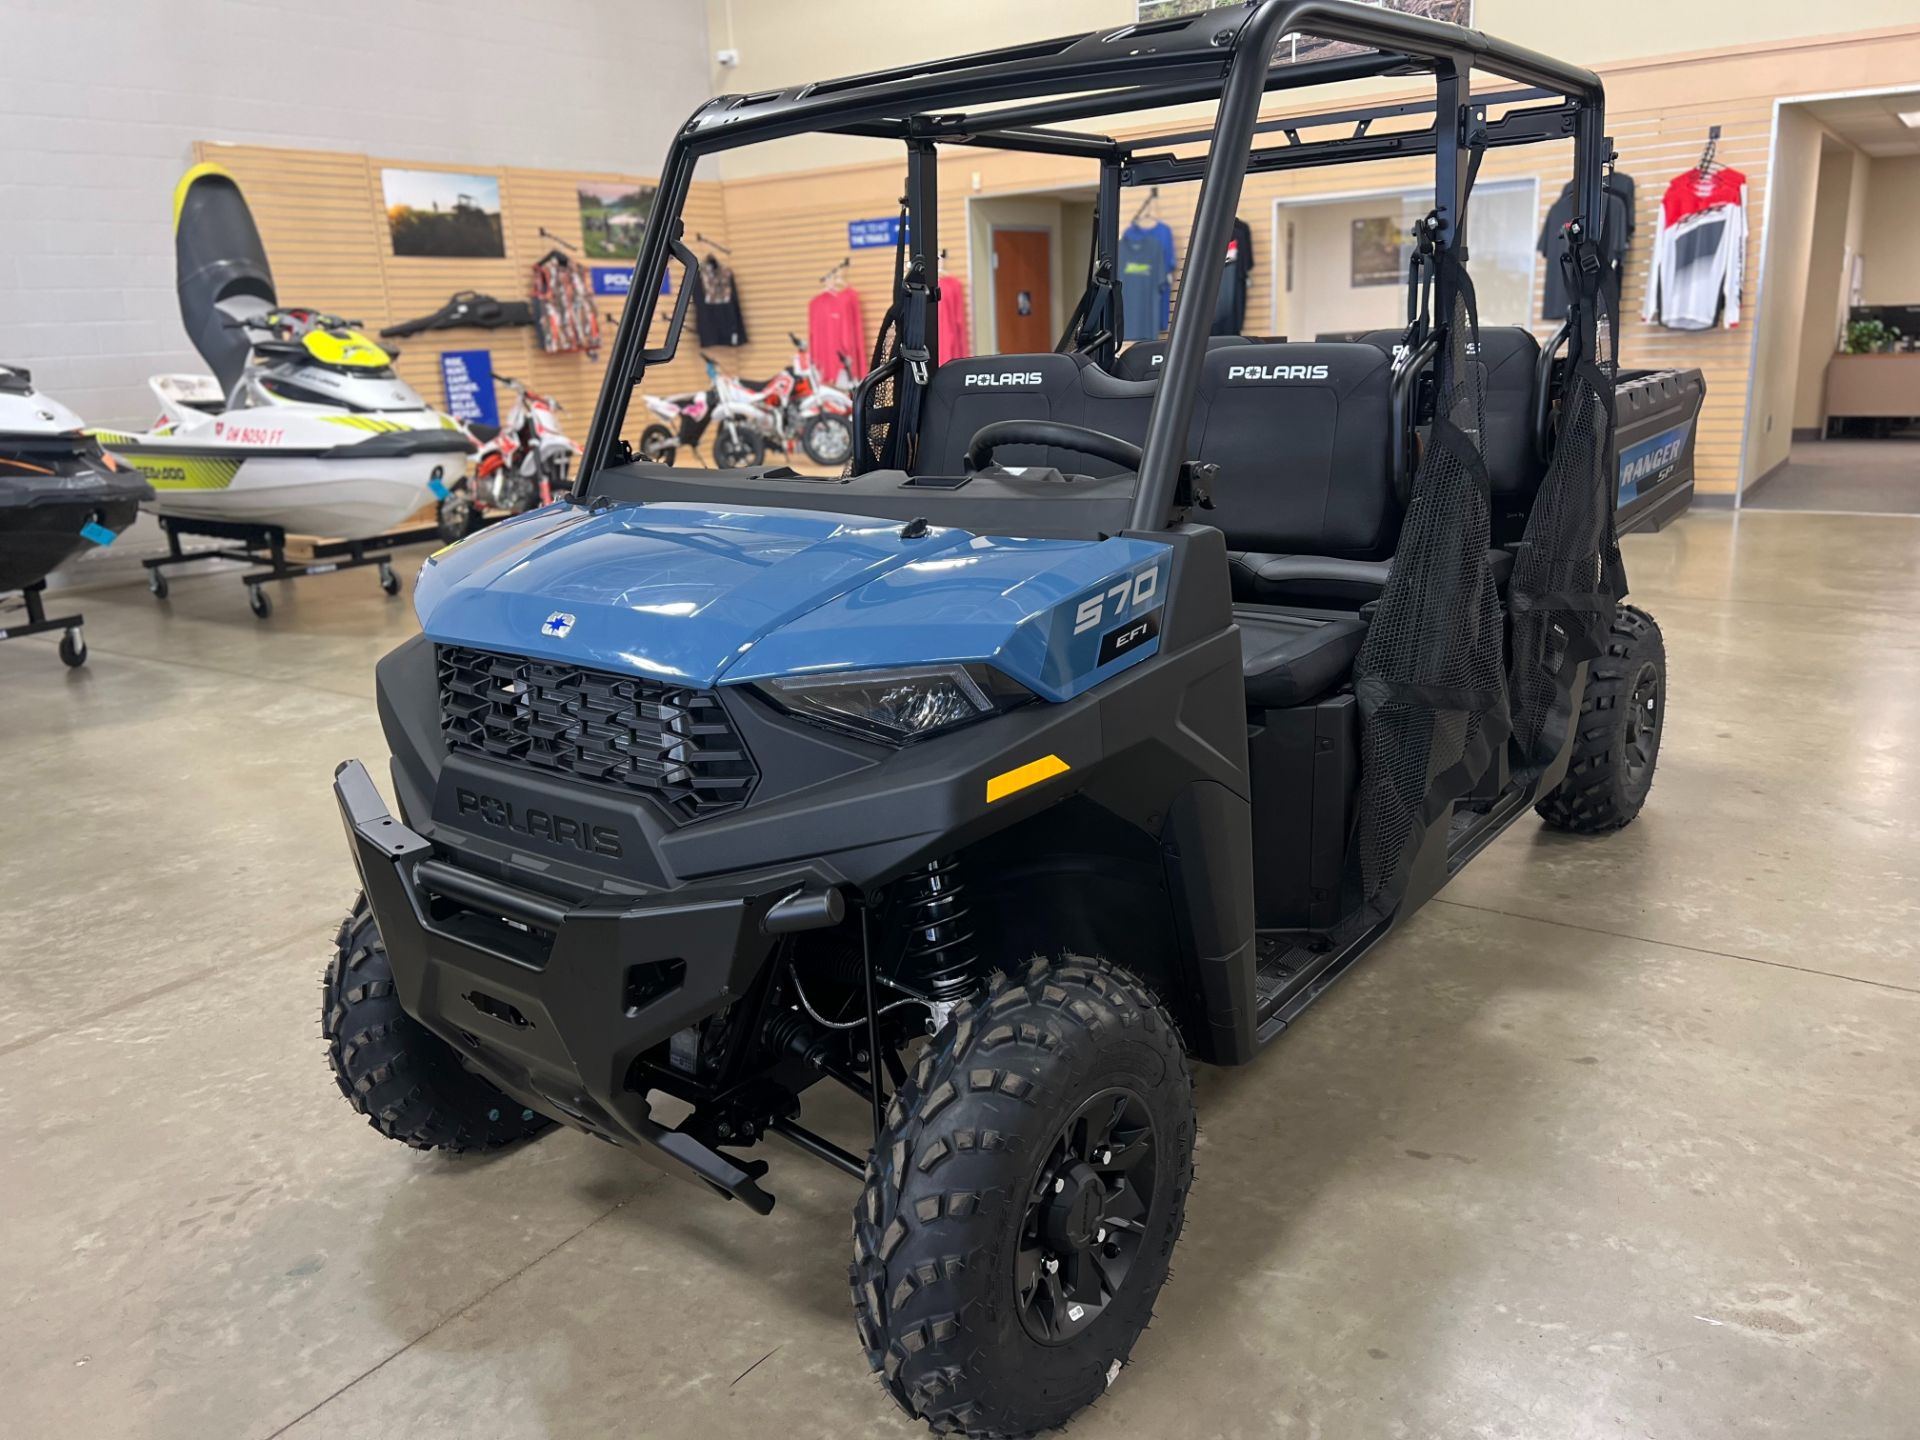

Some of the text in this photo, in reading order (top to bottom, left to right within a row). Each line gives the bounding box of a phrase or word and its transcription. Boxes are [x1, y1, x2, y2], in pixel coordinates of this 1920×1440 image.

[965, 372, 1042, 387] POLARIS
[1228, 365, 1329, 380] POLARIS
[1621, 439, 1681, 487] RANGER
[1073, 566, 1158, 635] 570
[1116, 623, 1148, 648] EFI
[456, 787, 624, 860] POLARIS
